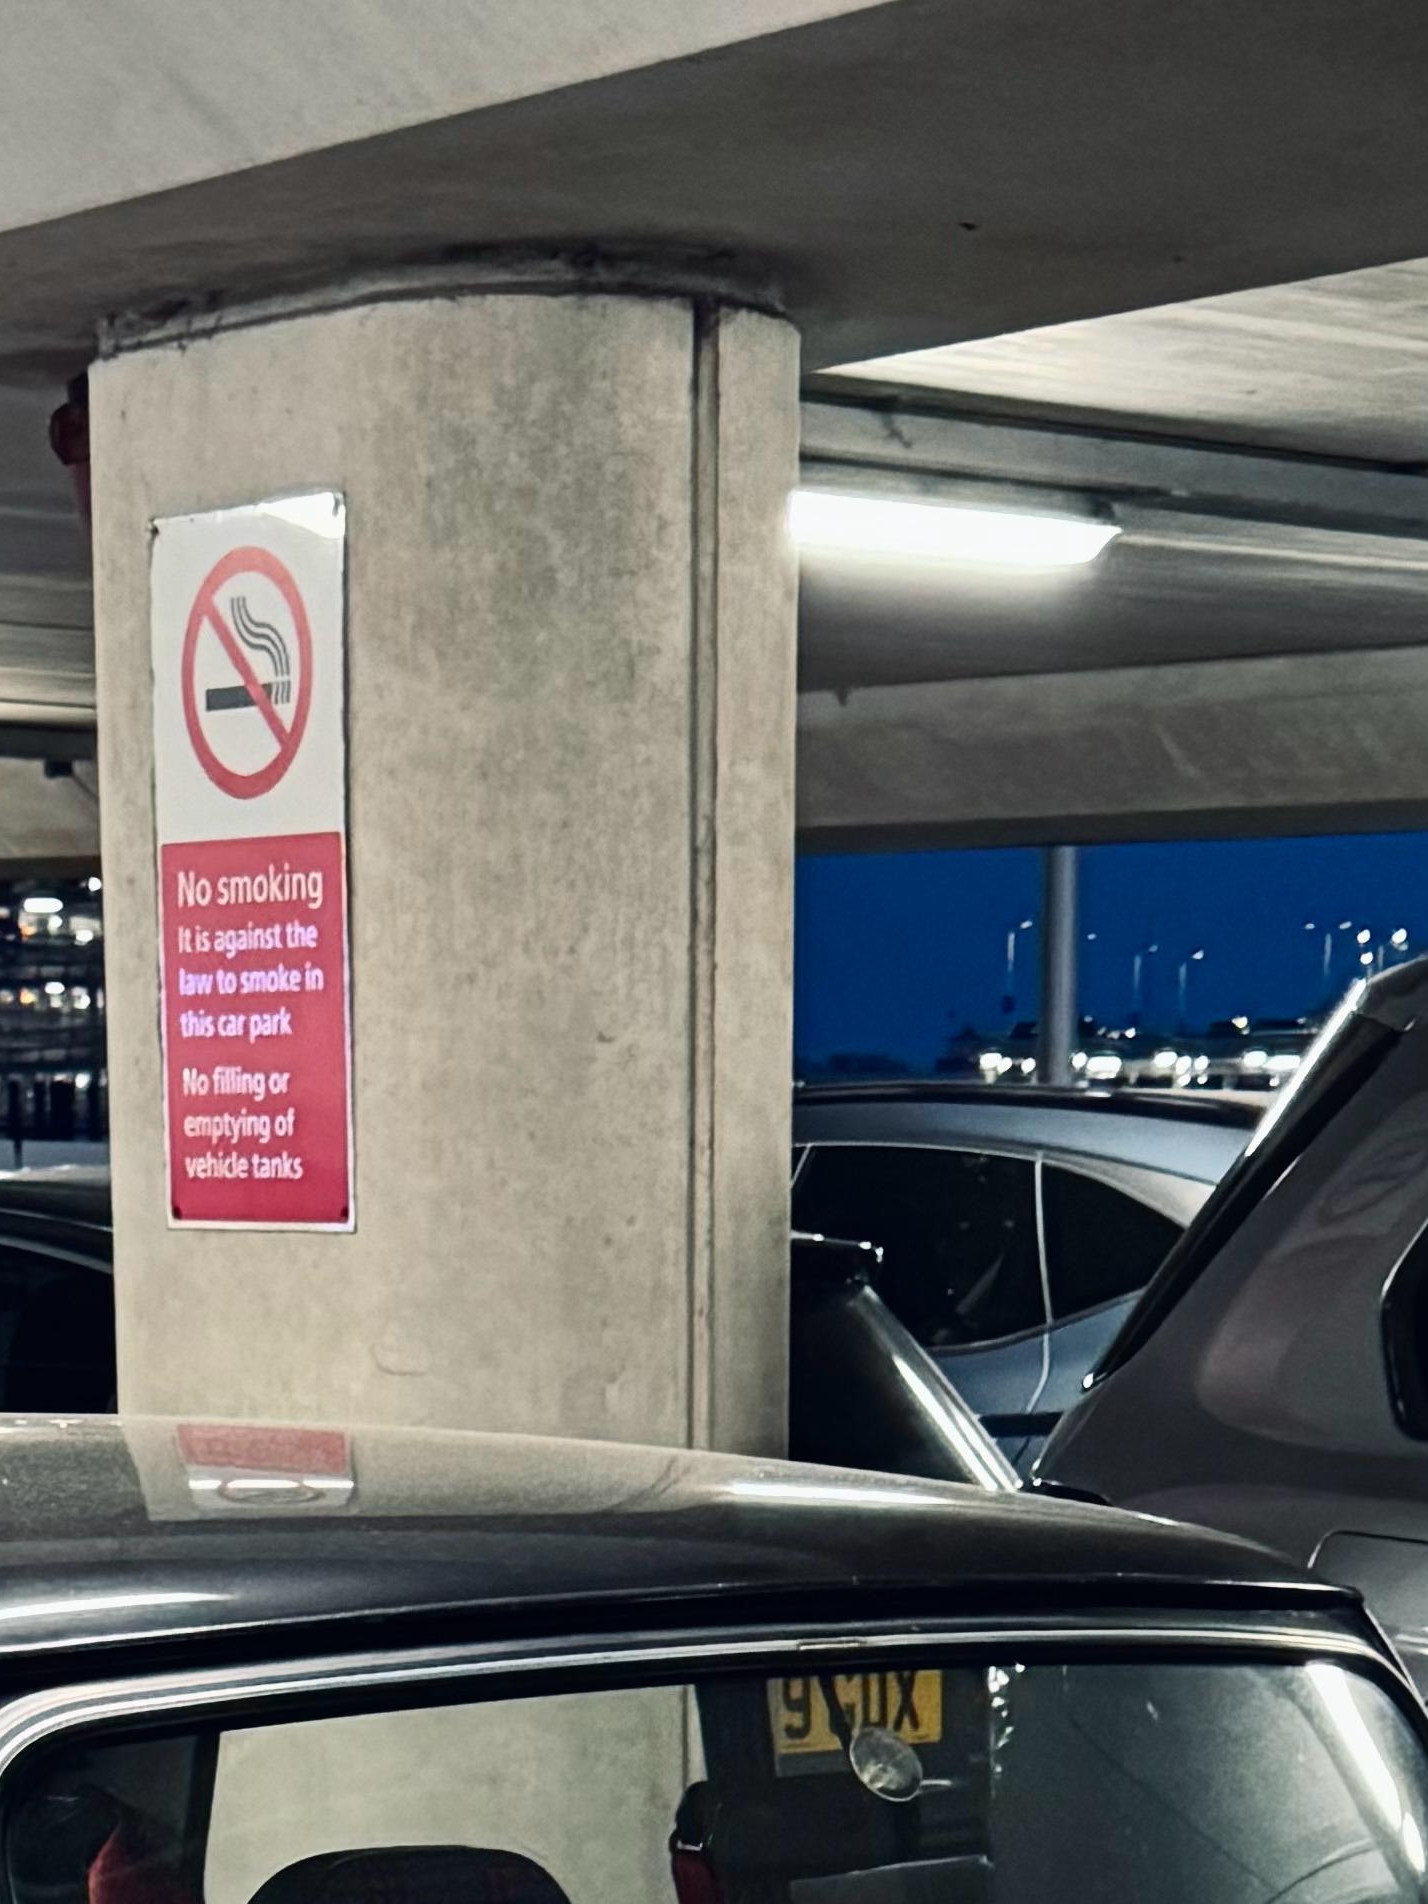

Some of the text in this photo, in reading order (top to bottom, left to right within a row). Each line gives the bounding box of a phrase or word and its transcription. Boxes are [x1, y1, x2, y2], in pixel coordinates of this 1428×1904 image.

[177, 862, 323, 909] No smoking
[178, 919, 318, 959] It is against the
[179, 960, 324, 996] law to smoke in
[180, 1006, 292, 1045] this car park
[182, 1065, 290, 1101] No filling or
[183, 1106, 295, 1145] emptying of
[184, 1151, 304, 1180] vehicle tanks
